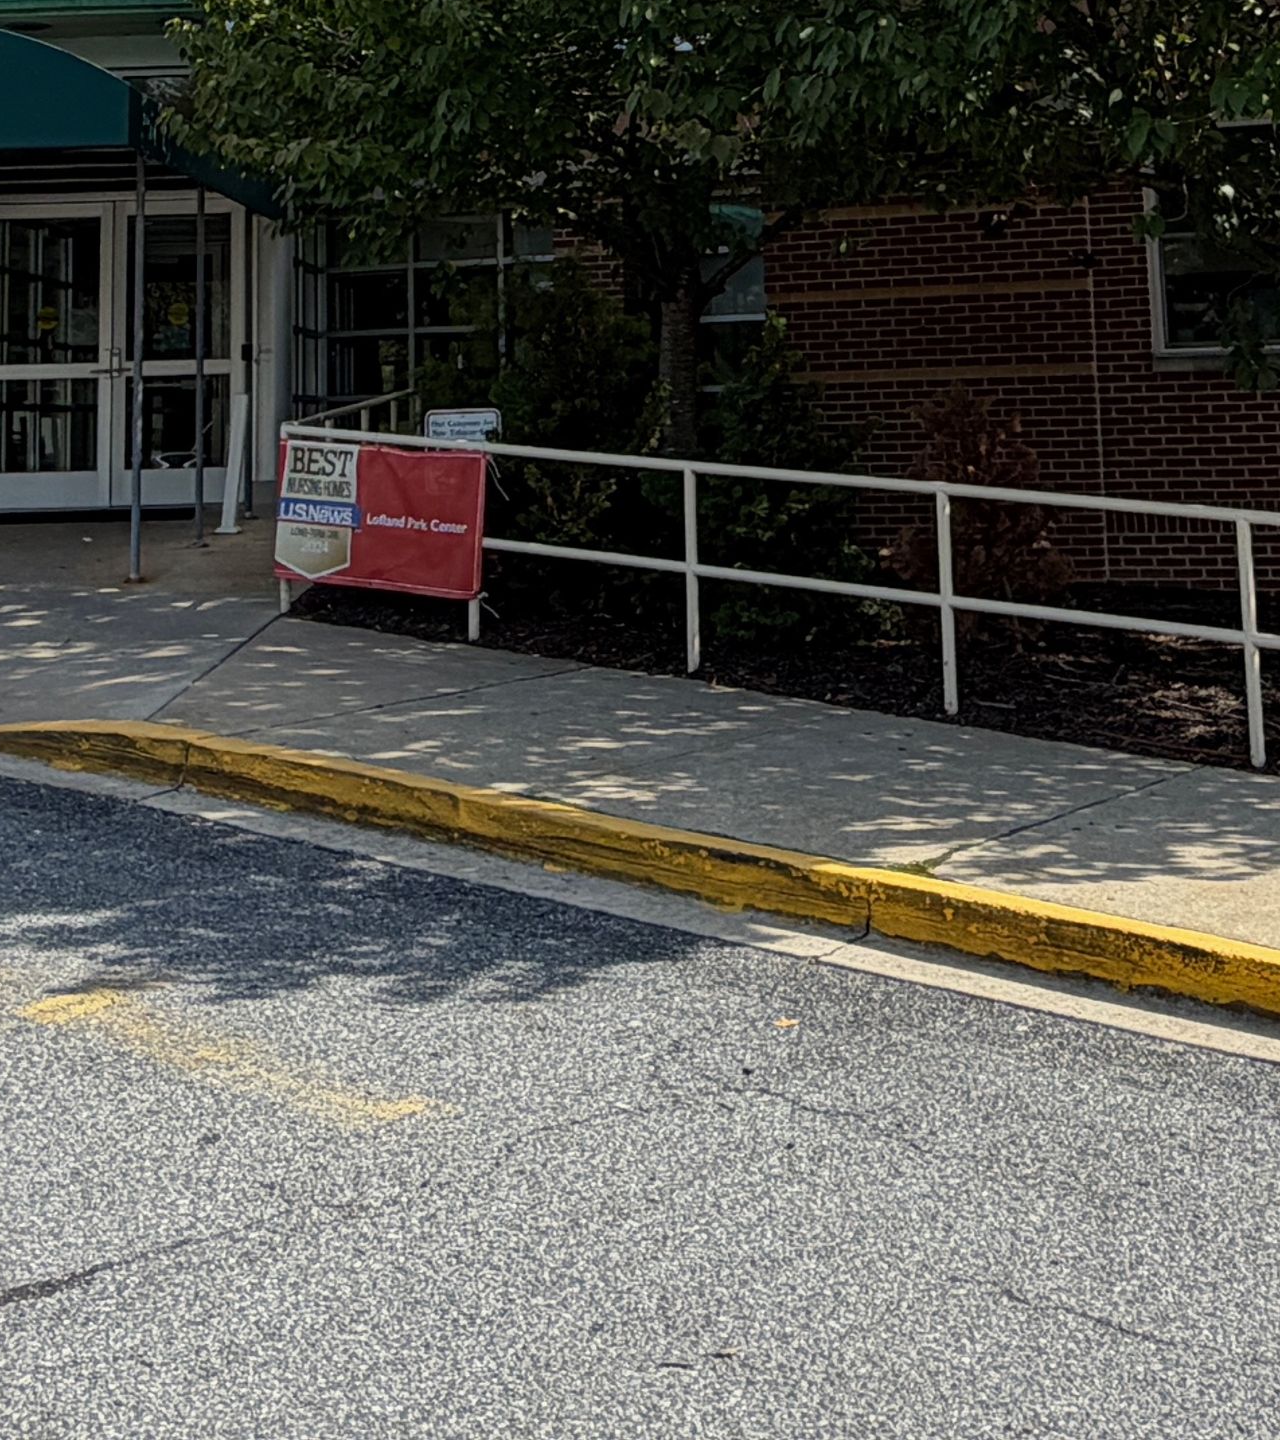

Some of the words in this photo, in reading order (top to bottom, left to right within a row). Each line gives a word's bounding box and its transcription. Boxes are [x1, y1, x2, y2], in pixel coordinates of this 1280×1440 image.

[290, 447, 353, 477] BEST
[287, 477, 322, 496] NURSING
[323, 480, 352, 498] HOMES
[430, 519, 467, 534] Center
